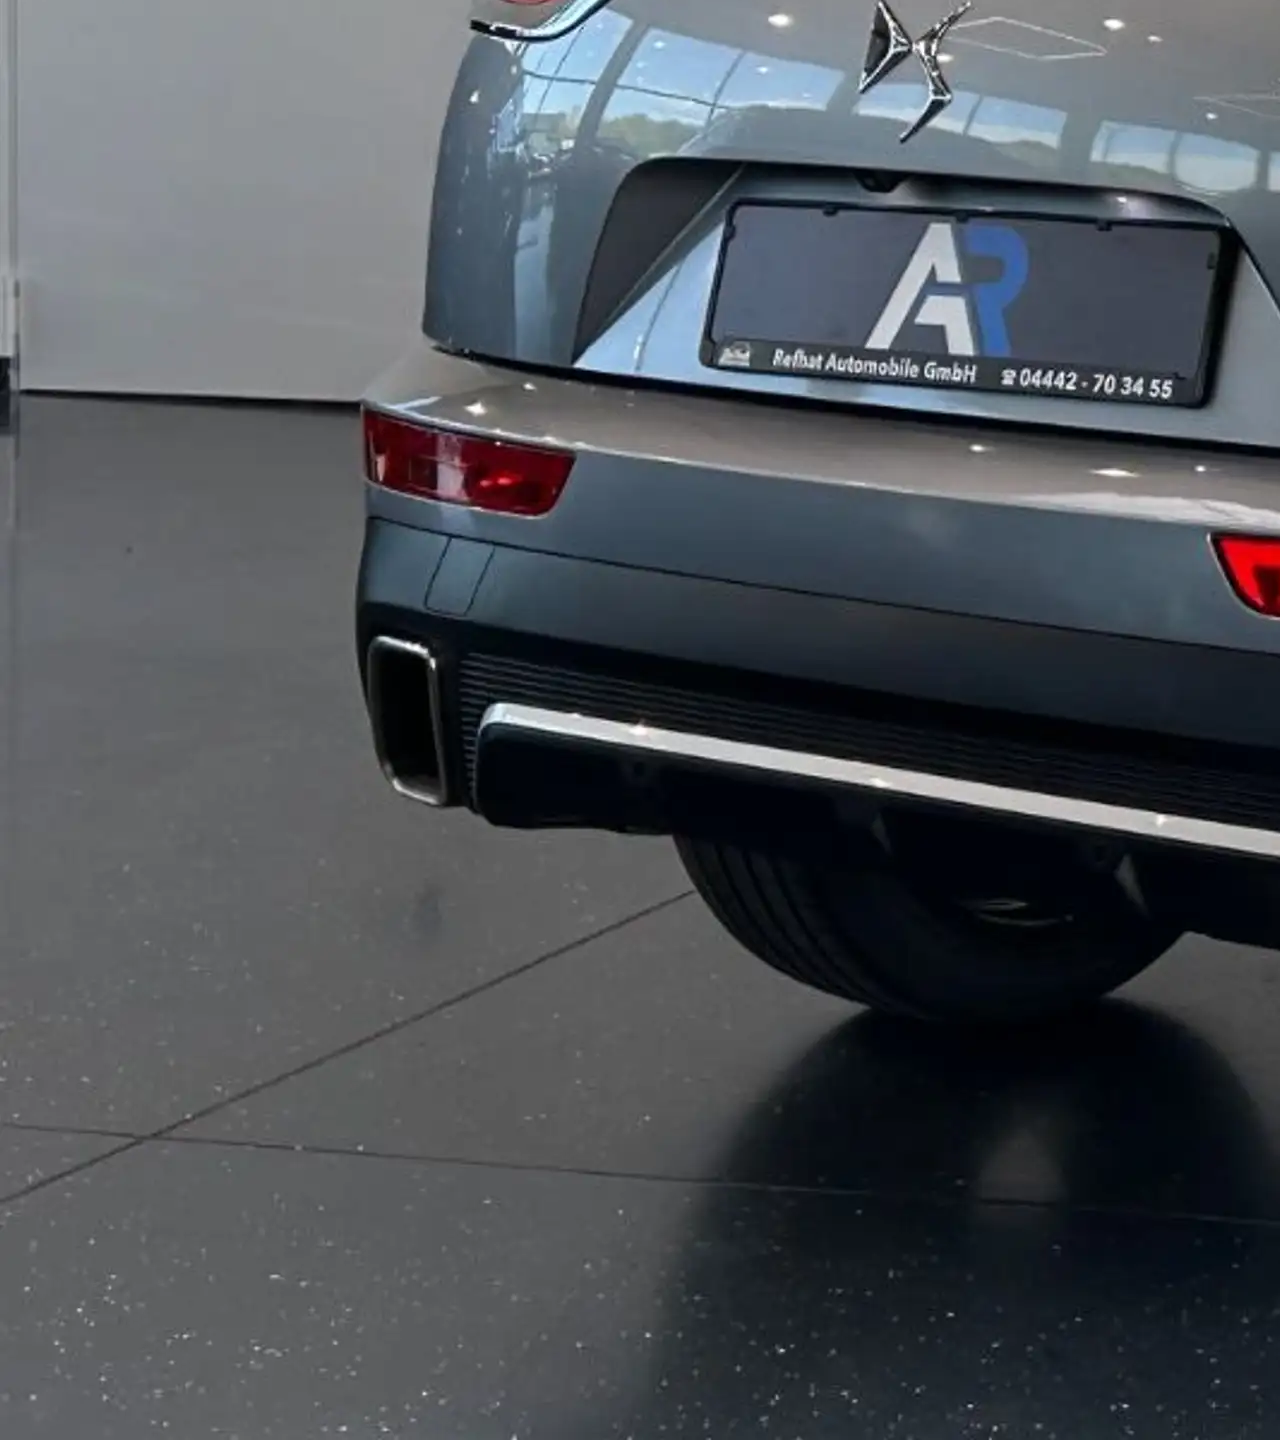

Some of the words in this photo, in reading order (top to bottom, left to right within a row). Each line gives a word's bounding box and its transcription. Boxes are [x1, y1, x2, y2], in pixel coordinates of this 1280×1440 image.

[864, 221, 1030, 359] AR
[825, 352, 920, 379] Automobile
[923, 361, 978, 383] GmbH
[1019, 367, 1078, 391] 04442
[1092, 373, 1117, 395] 70
[1120, 375, 1145, 397] 34
[1149, 378, 1174, 399] 55
